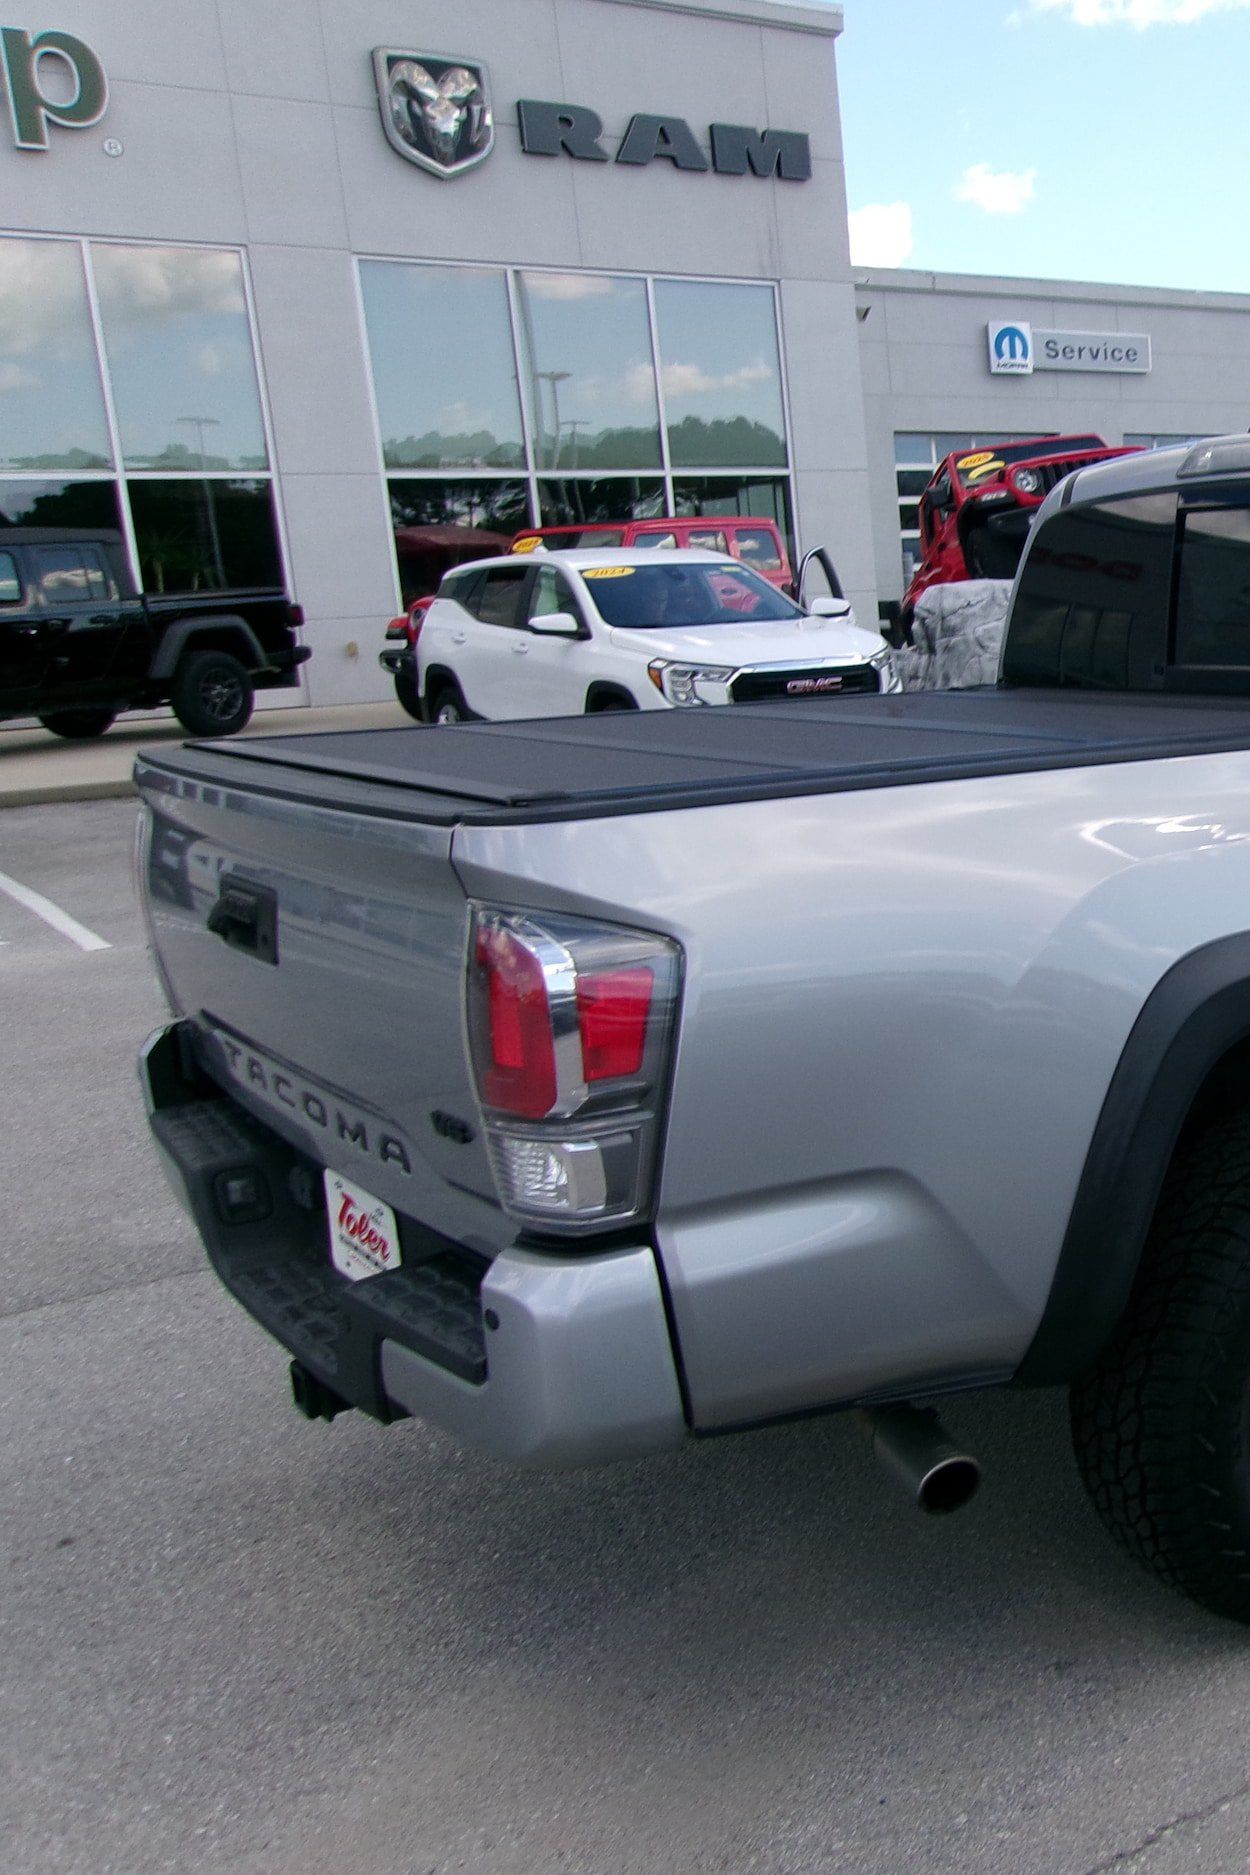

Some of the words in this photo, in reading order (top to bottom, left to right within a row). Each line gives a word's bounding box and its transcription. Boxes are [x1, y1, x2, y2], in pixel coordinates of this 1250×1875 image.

[517, 99, 811, 181] RAM
[1045, 339, 1138, 362] Service
[787, 676, 842, 694] GMC
[224, 1040, 411, 1174] TACOMA
[338, 1191, 391, 1262] Toler
